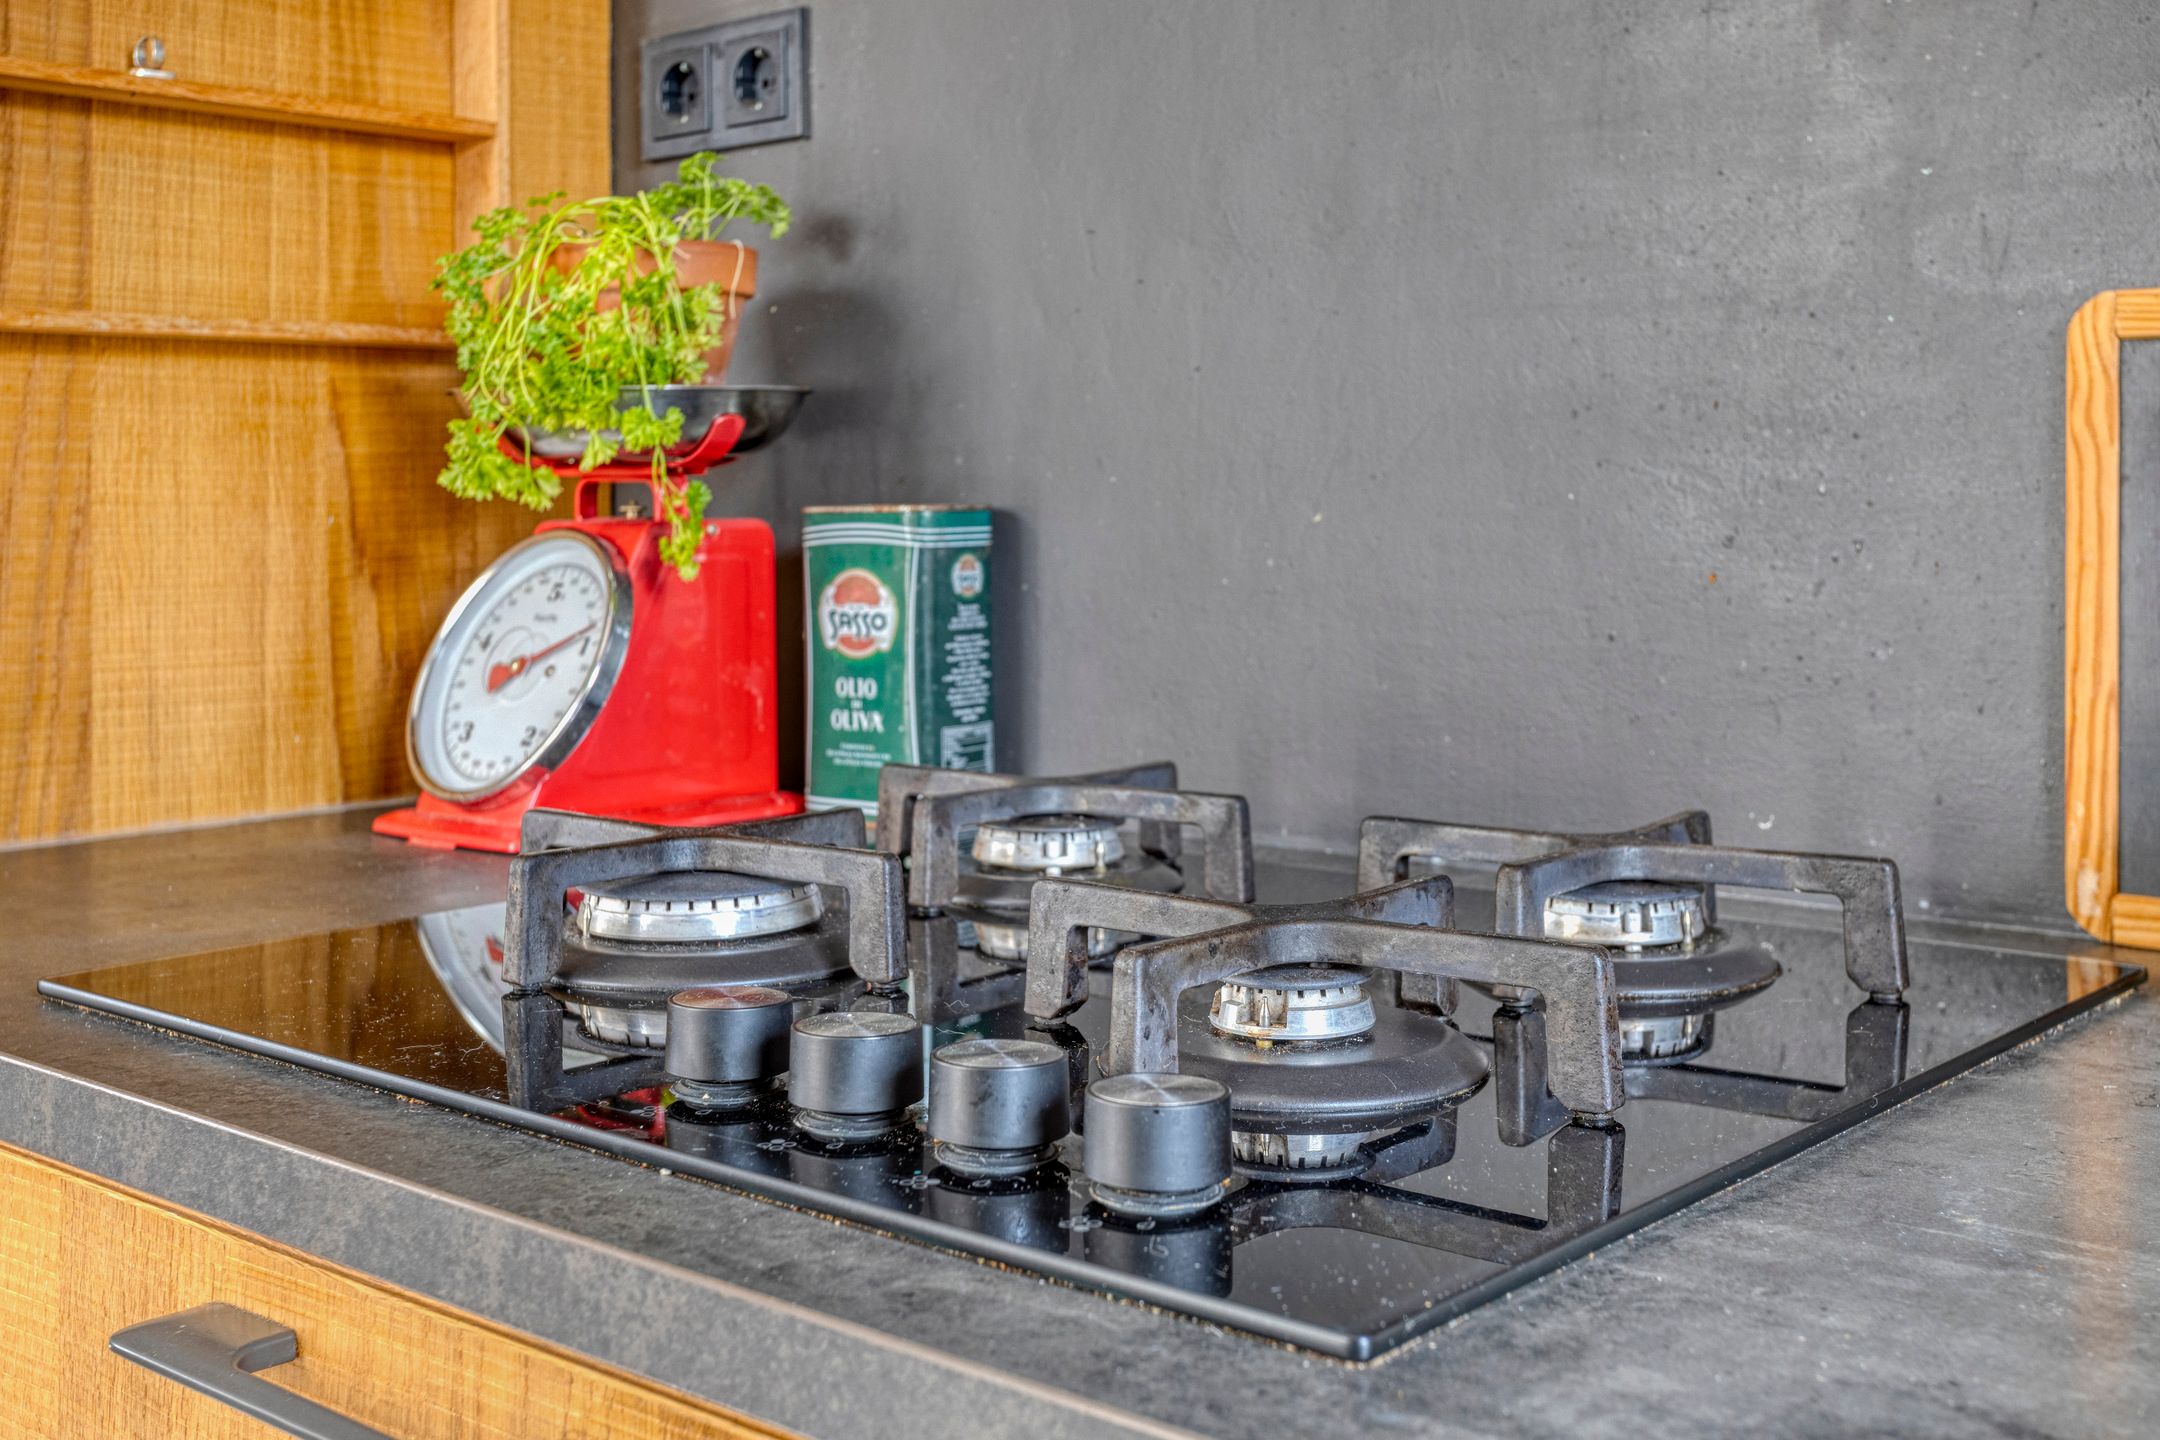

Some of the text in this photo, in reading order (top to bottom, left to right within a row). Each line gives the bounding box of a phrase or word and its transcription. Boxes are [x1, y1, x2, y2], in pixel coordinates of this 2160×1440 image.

[828, 609, 887, 641] SASSO
[835, 676, 878, 701] OLIO
[459, 720, 475, 743] 3
[829, 707, 884, 734] OLIVA
[520, 724, 537, 747] 2
